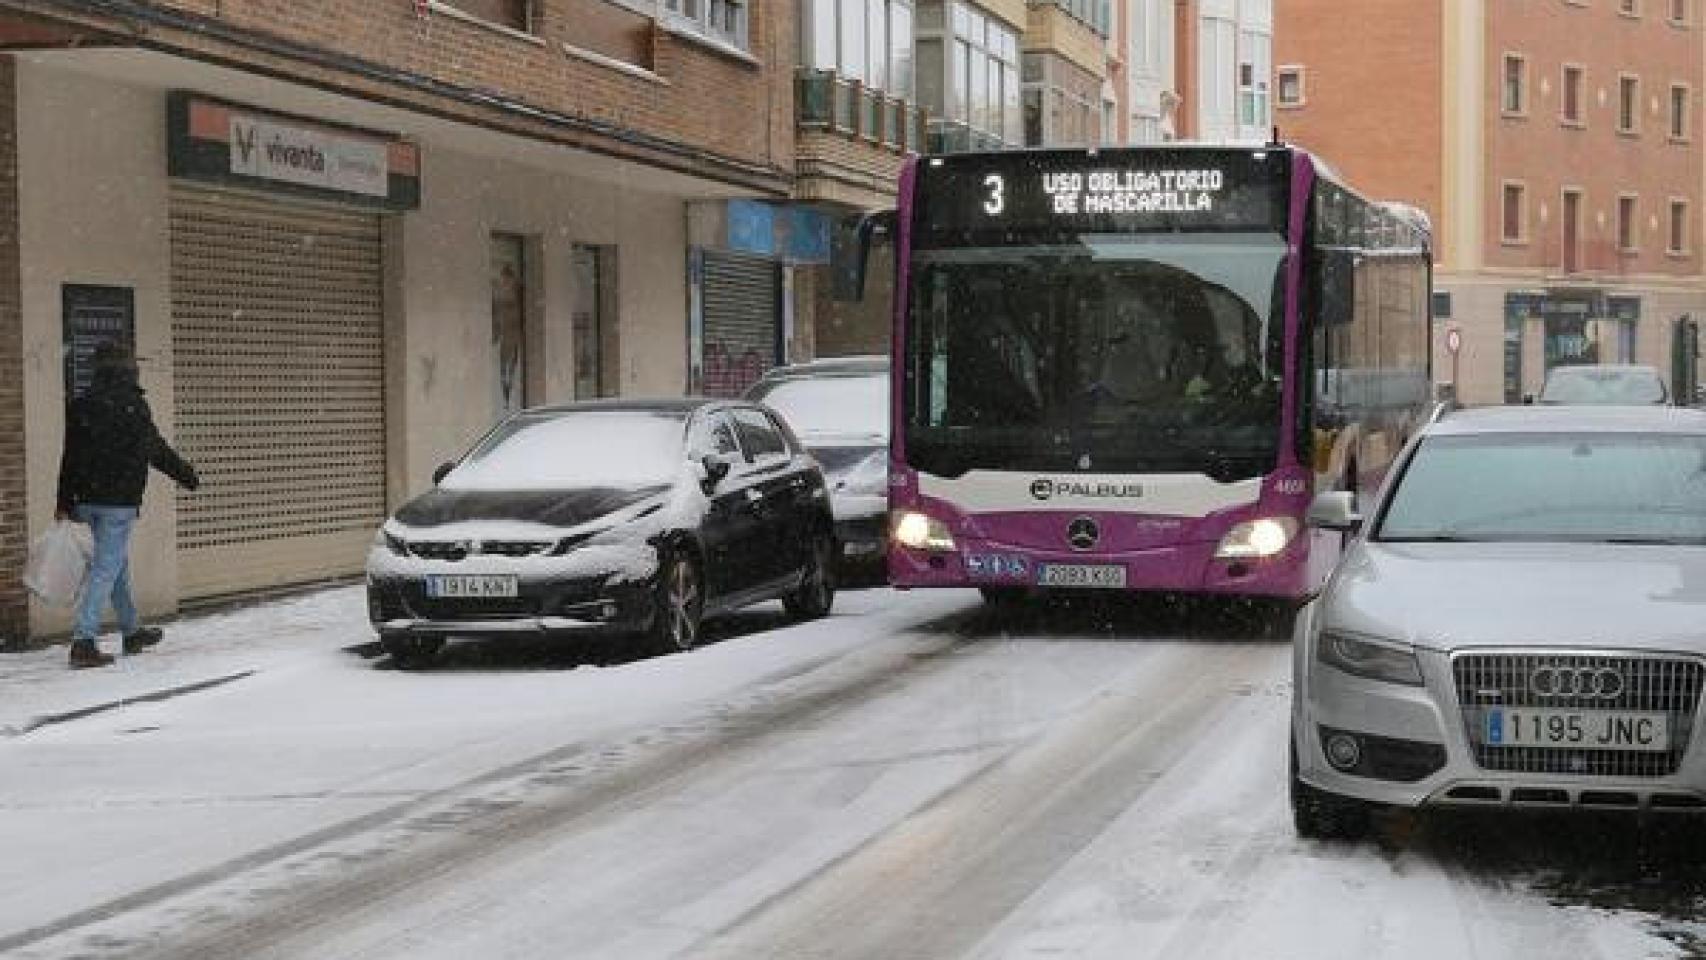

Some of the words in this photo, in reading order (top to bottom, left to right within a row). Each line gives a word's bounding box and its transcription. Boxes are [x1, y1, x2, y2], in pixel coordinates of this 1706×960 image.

[267, 133, 325, 172] vivanta
[983, 175, 1004, 214] 3
[1043, 172, 1082, 194] USO
[1088, 169, 1223, 192] OBLIGATORIO
[1054, 193, 1079, 214] DE
[1085, 192, 1213, 212] MASCARILLA
[1057, 481, 1144, 498] PALBUS
[1511, 713, 1584, 742] 1195
[1597, 715, 1653, 745] JNC
